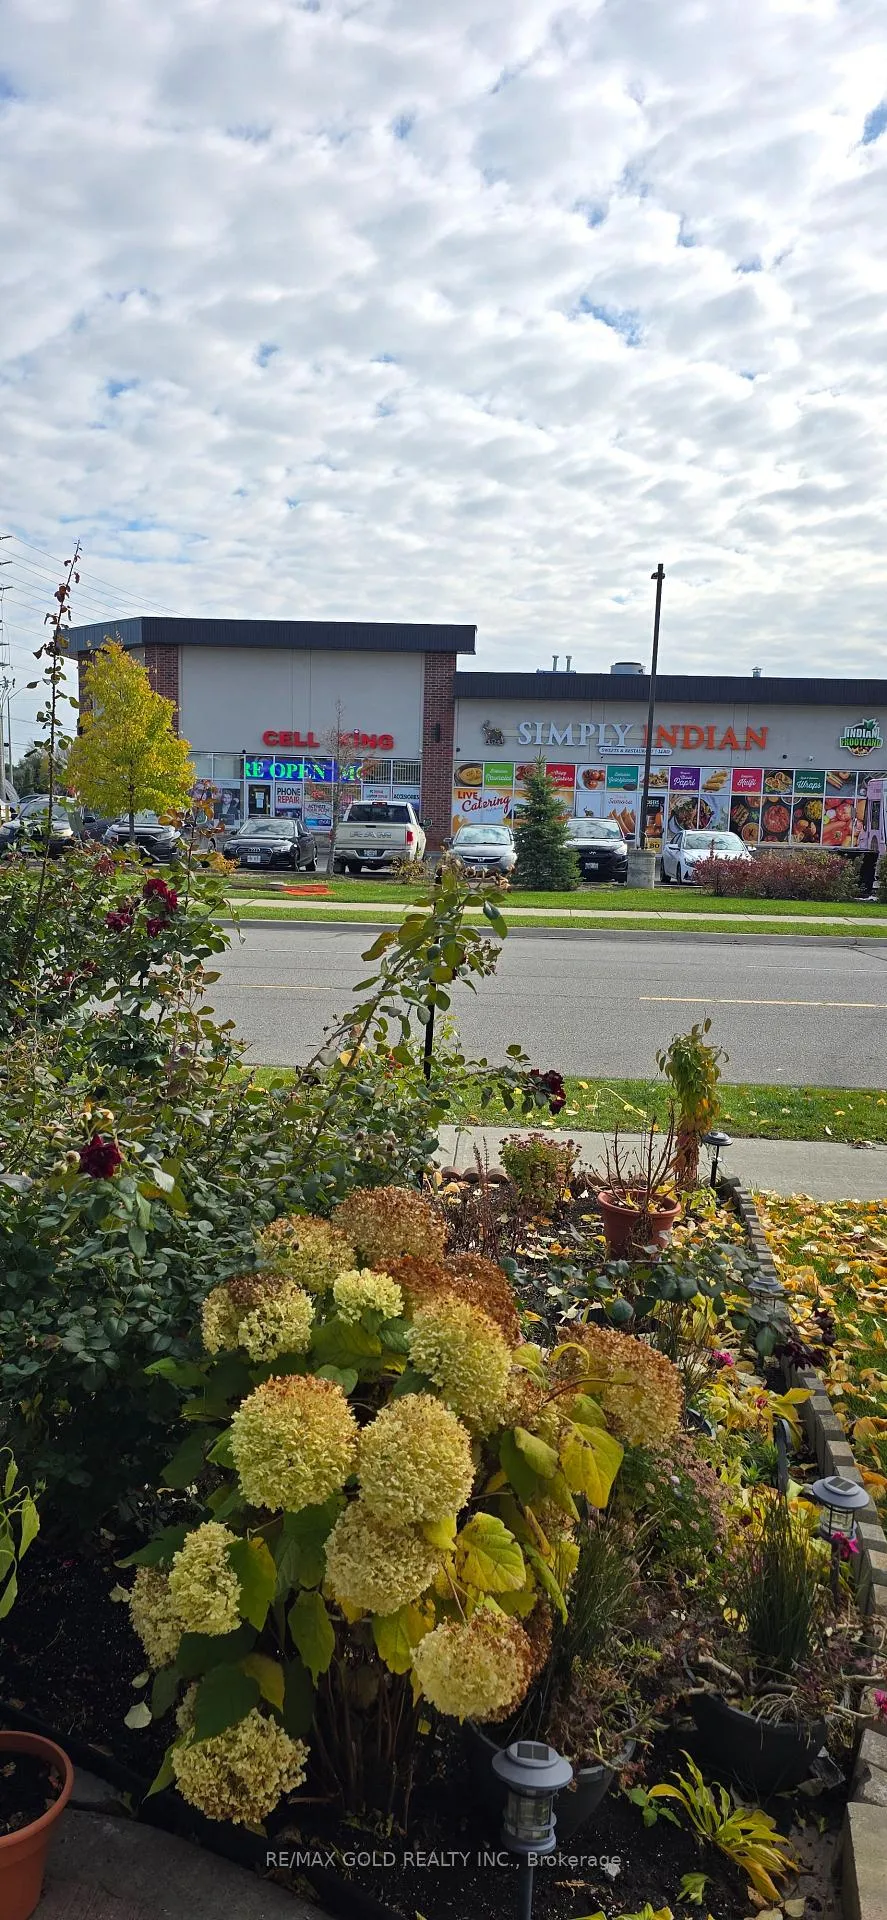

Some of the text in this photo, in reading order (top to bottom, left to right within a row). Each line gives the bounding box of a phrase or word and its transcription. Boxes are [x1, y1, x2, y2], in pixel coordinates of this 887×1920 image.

[518, 722, 769, 751] SIMPLY INDIAN
[847, 728, 878, 738] INDIAN
[262, 730, 320, 748] CELL
[841, 738, 881, 747] FROOTLAND
[270, 763, 327, 780] OPEN
[796, 780, 822, 790] Wraps
[277, 788, 301, 796] PHONE
[458, 791, 478, 799] LIVE
[277, 796, 300, 804] REPAIR
[462, 795, 511, 814] Catering
